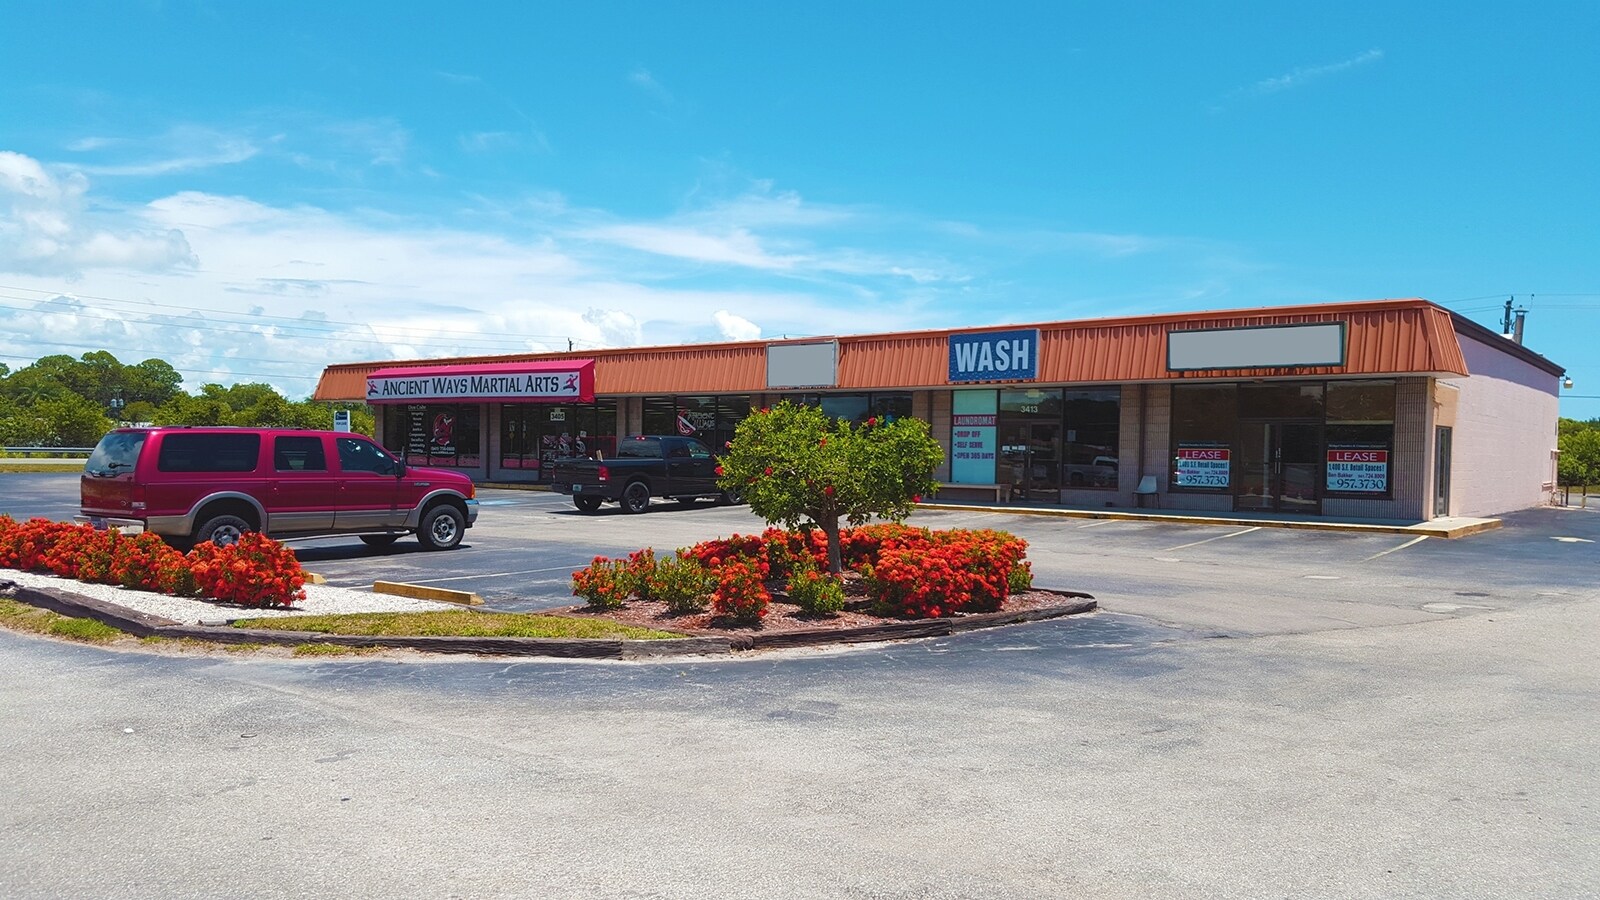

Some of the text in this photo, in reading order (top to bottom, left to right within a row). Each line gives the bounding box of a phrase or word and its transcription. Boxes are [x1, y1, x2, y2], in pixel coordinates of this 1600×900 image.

[954, 339, 1030, 373] WASH
[382, 375, 559, 396] ANCIENT WAYS MARTIAL ARTS
[1020, 405, 1038, 413] 3413
[954, 416, 996, 425] LAUNDROMAT
[1185, 451, 1221, 459] LEASE
[1336, 452, 1377, 461] LEASE
[1350, 463, 1364, 471] Retail
[1364, 463, 1385, 472] Spaces!
[1185, 475, 1227, 485] 957.3730
[1336, 478, 1384, 490] 957.3730
